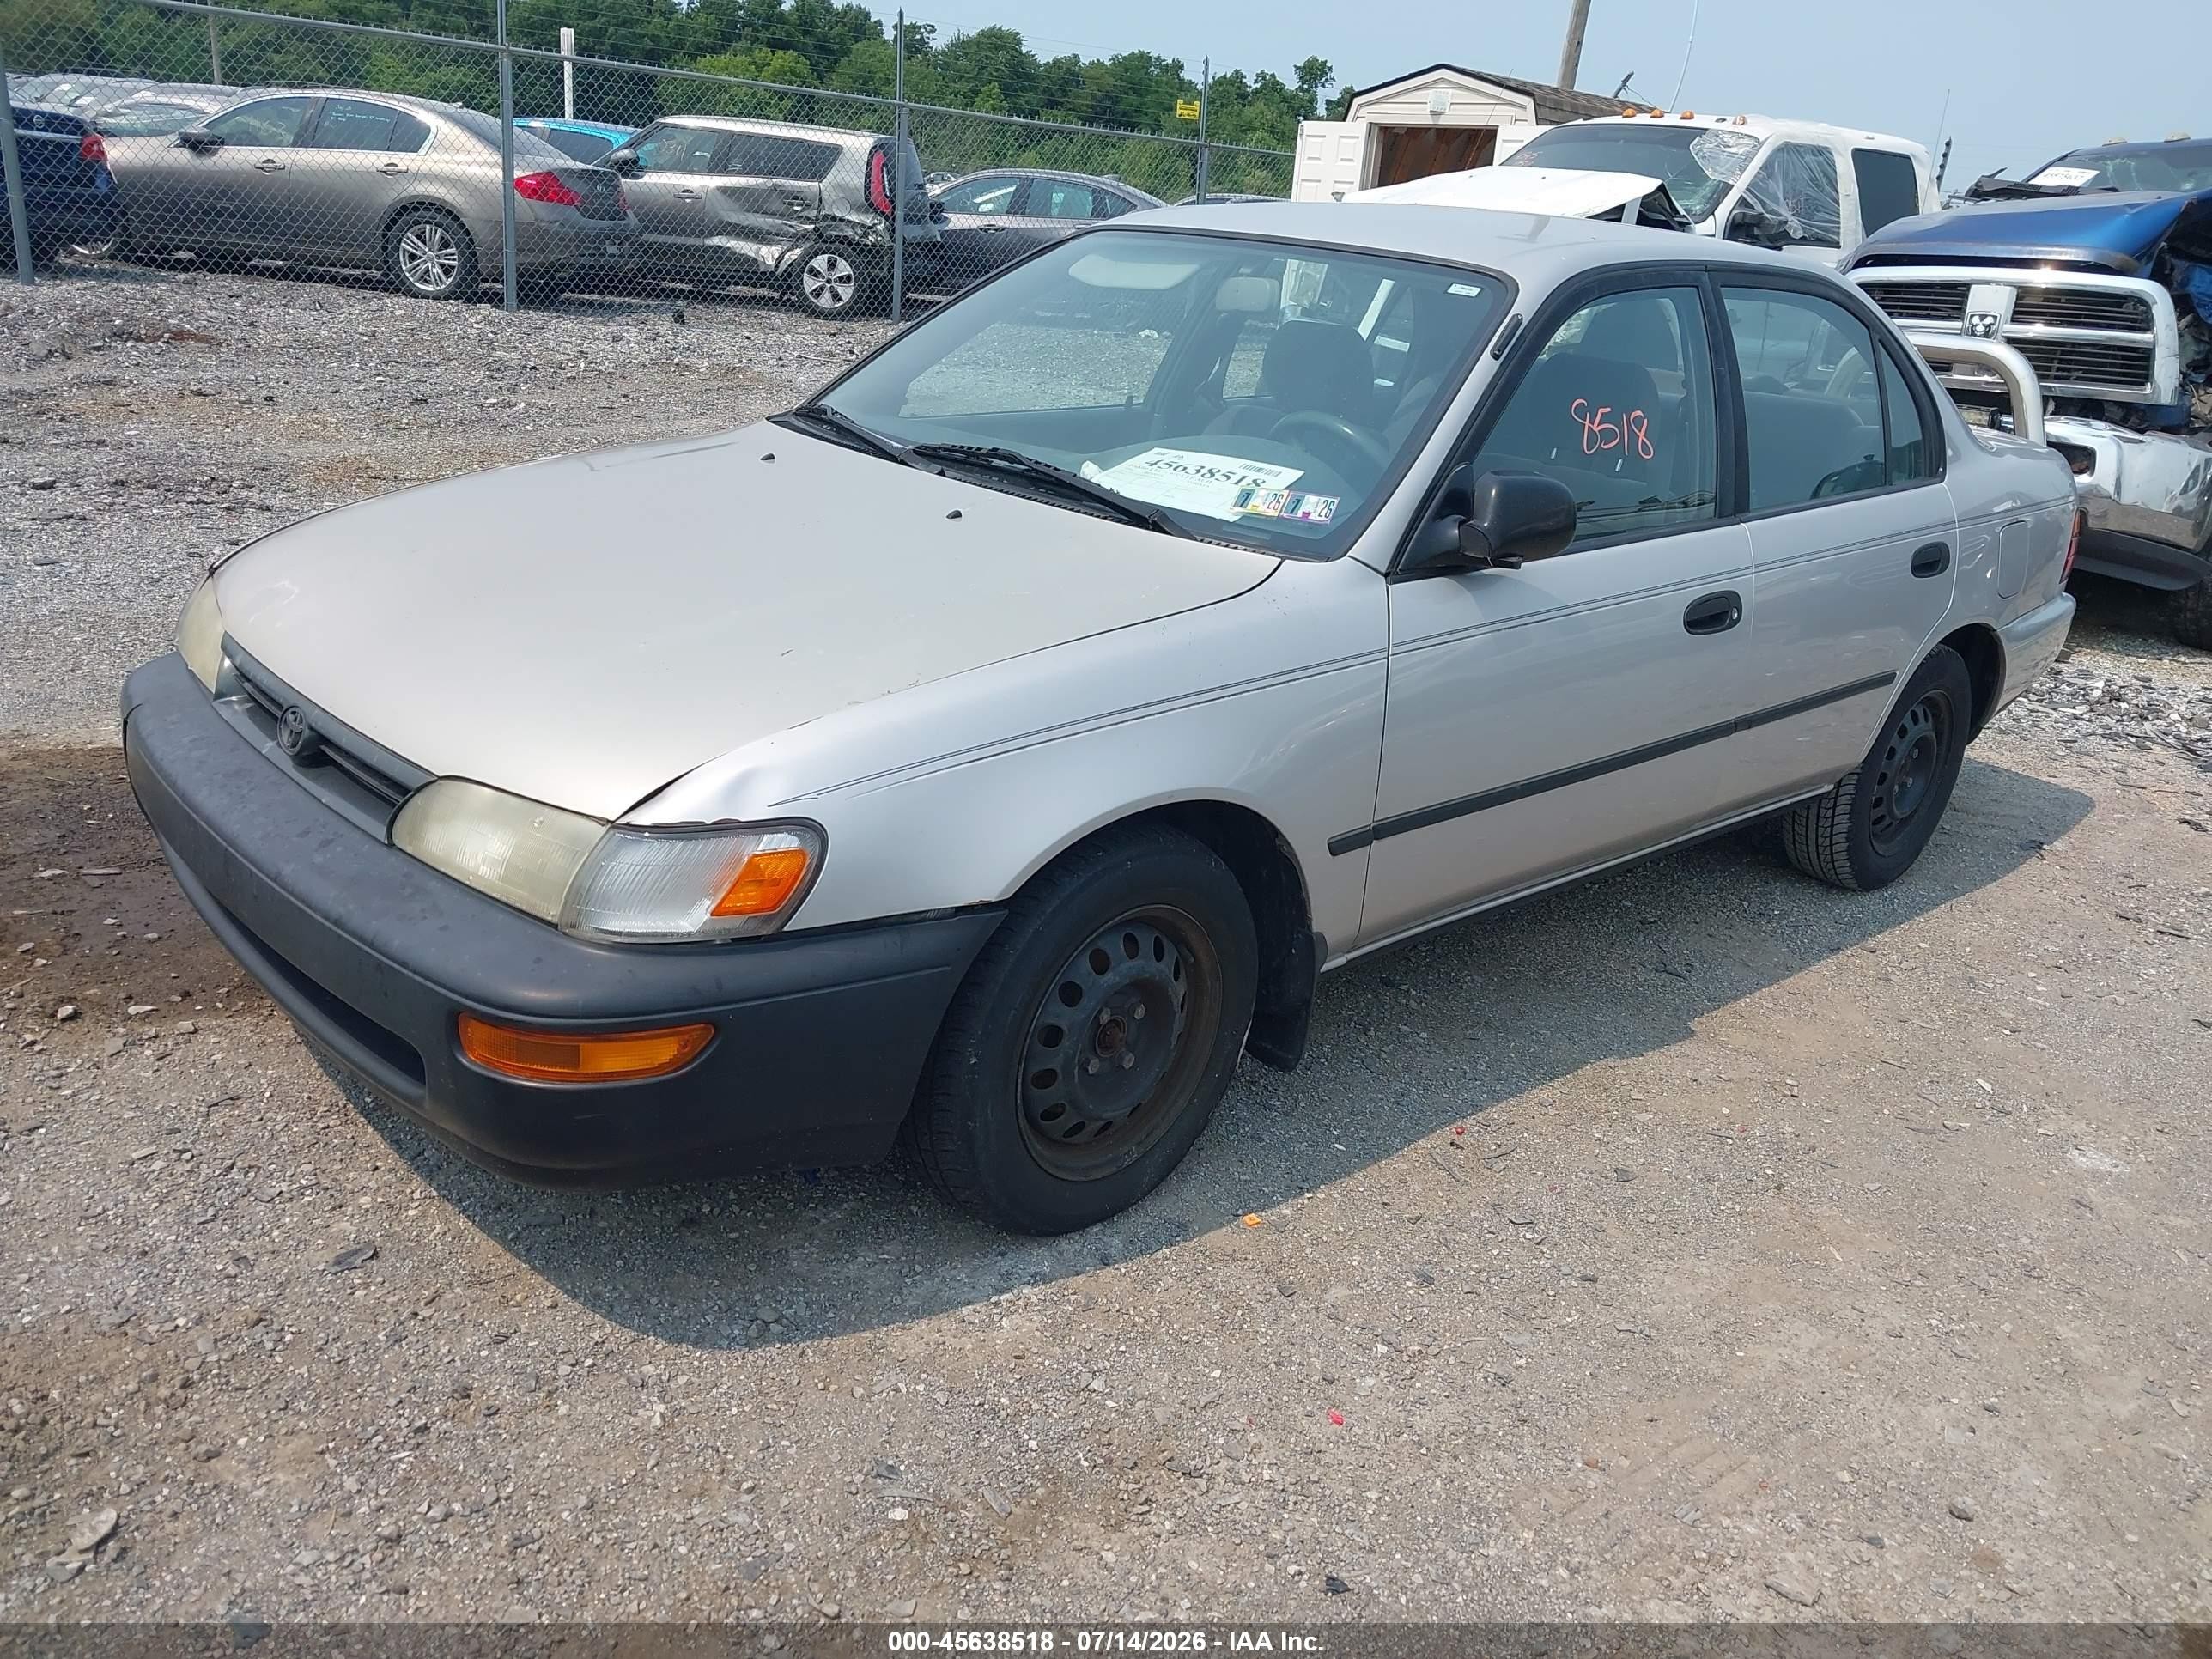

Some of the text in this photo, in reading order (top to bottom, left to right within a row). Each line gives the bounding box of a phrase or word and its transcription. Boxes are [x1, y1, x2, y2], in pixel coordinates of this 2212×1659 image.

[1571, 398, 1654, 459] 8518
[1145, 459, 1267, 488] 45638518
[1239, 492, 1285, 511] 7 26
[1289, 498, 1335, 519] 7 26
